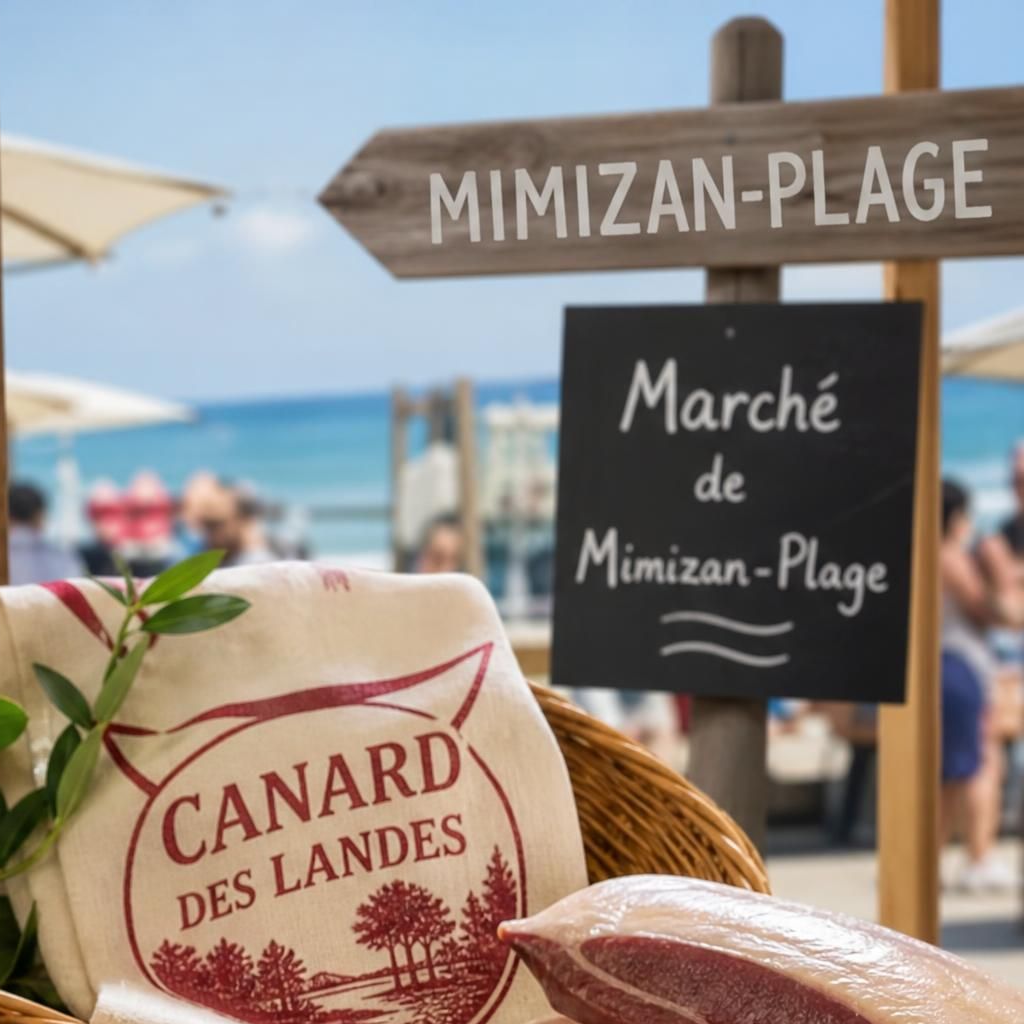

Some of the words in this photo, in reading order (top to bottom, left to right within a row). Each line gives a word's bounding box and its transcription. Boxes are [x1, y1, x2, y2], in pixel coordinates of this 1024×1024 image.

[430, 138, 991, 243] MIMIZAN-PLAGE
[620, 359, 839, 434] Marché
[695, 455, 744, 502] de
[576, 528, 889, 616] Mimizan-Plage
[162, 730, 462, 865] CANARD
[177, 869, 256, 930] DES
[270, 813, 467, 897] LANDES
